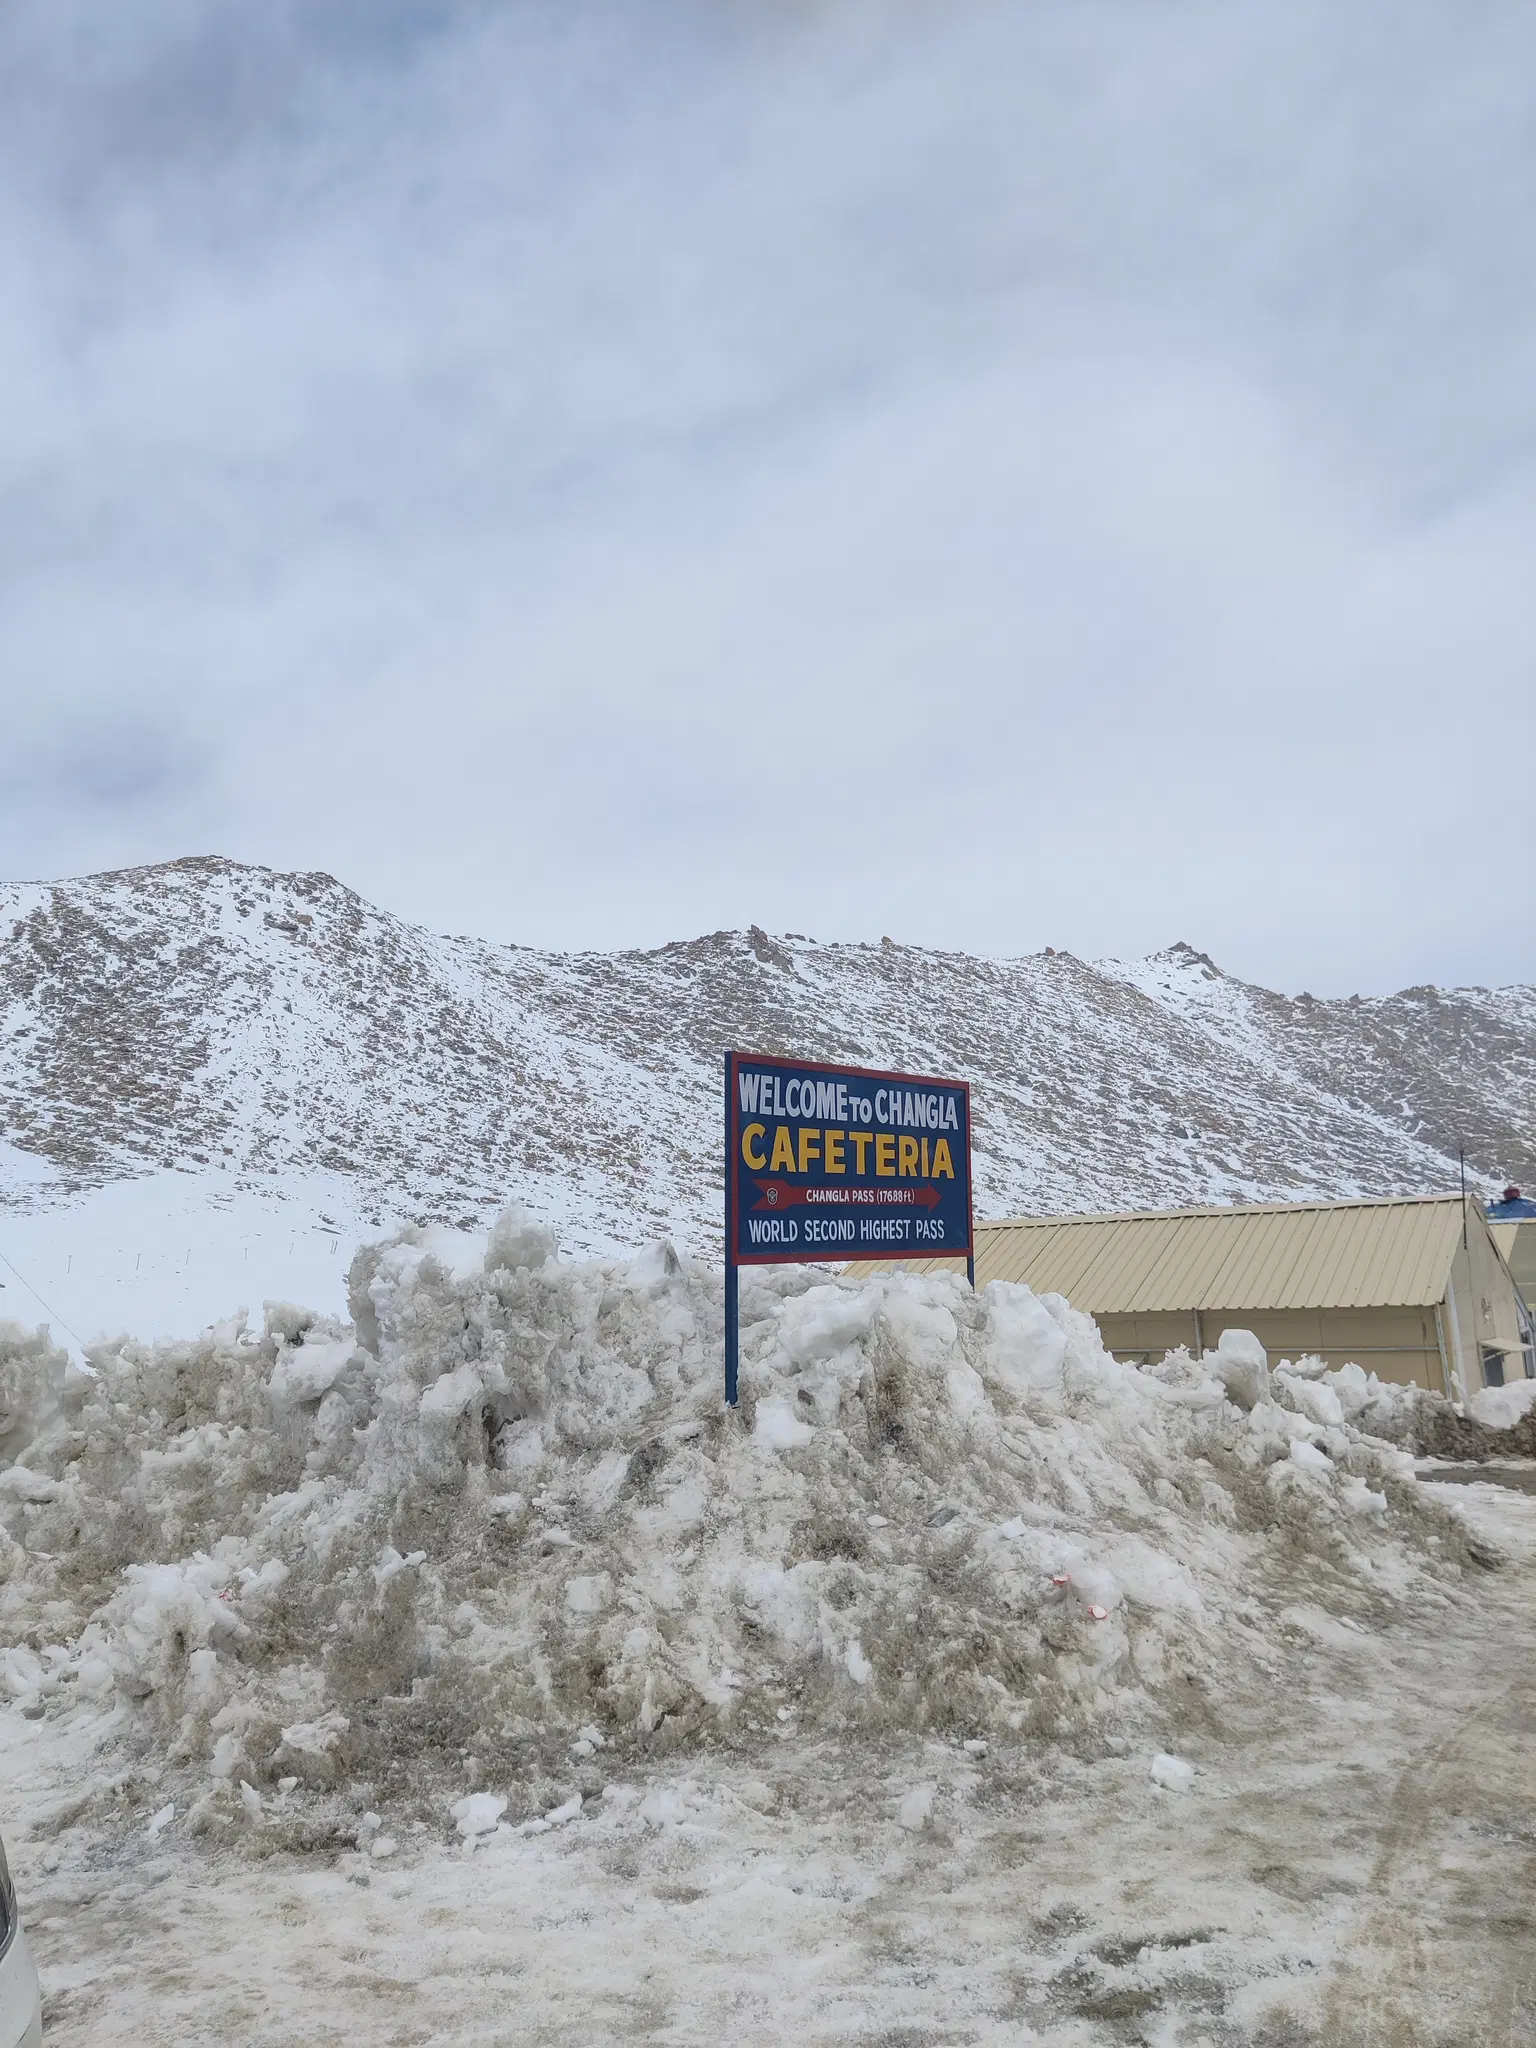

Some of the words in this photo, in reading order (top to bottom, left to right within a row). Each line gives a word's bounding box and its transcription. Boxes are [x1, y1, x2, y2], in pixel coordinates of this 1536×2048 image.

[738, 1072, 848, 1121] WELCOME
[875, 1089, 959, 1130] CHANGLA
[741, 1122, 955, 1179] CAFETERIA
[806, 1189, 850, 1203] CHANGLA
[852, 1190, 875, 1203] PASS
[748, 1219, 798, 1243] WORLD
[804, 1220, 856, 1242] SECOND
[860, 1219, 911, 1240] HIGHEST
[915, 1219, 945, 1239] PASS
